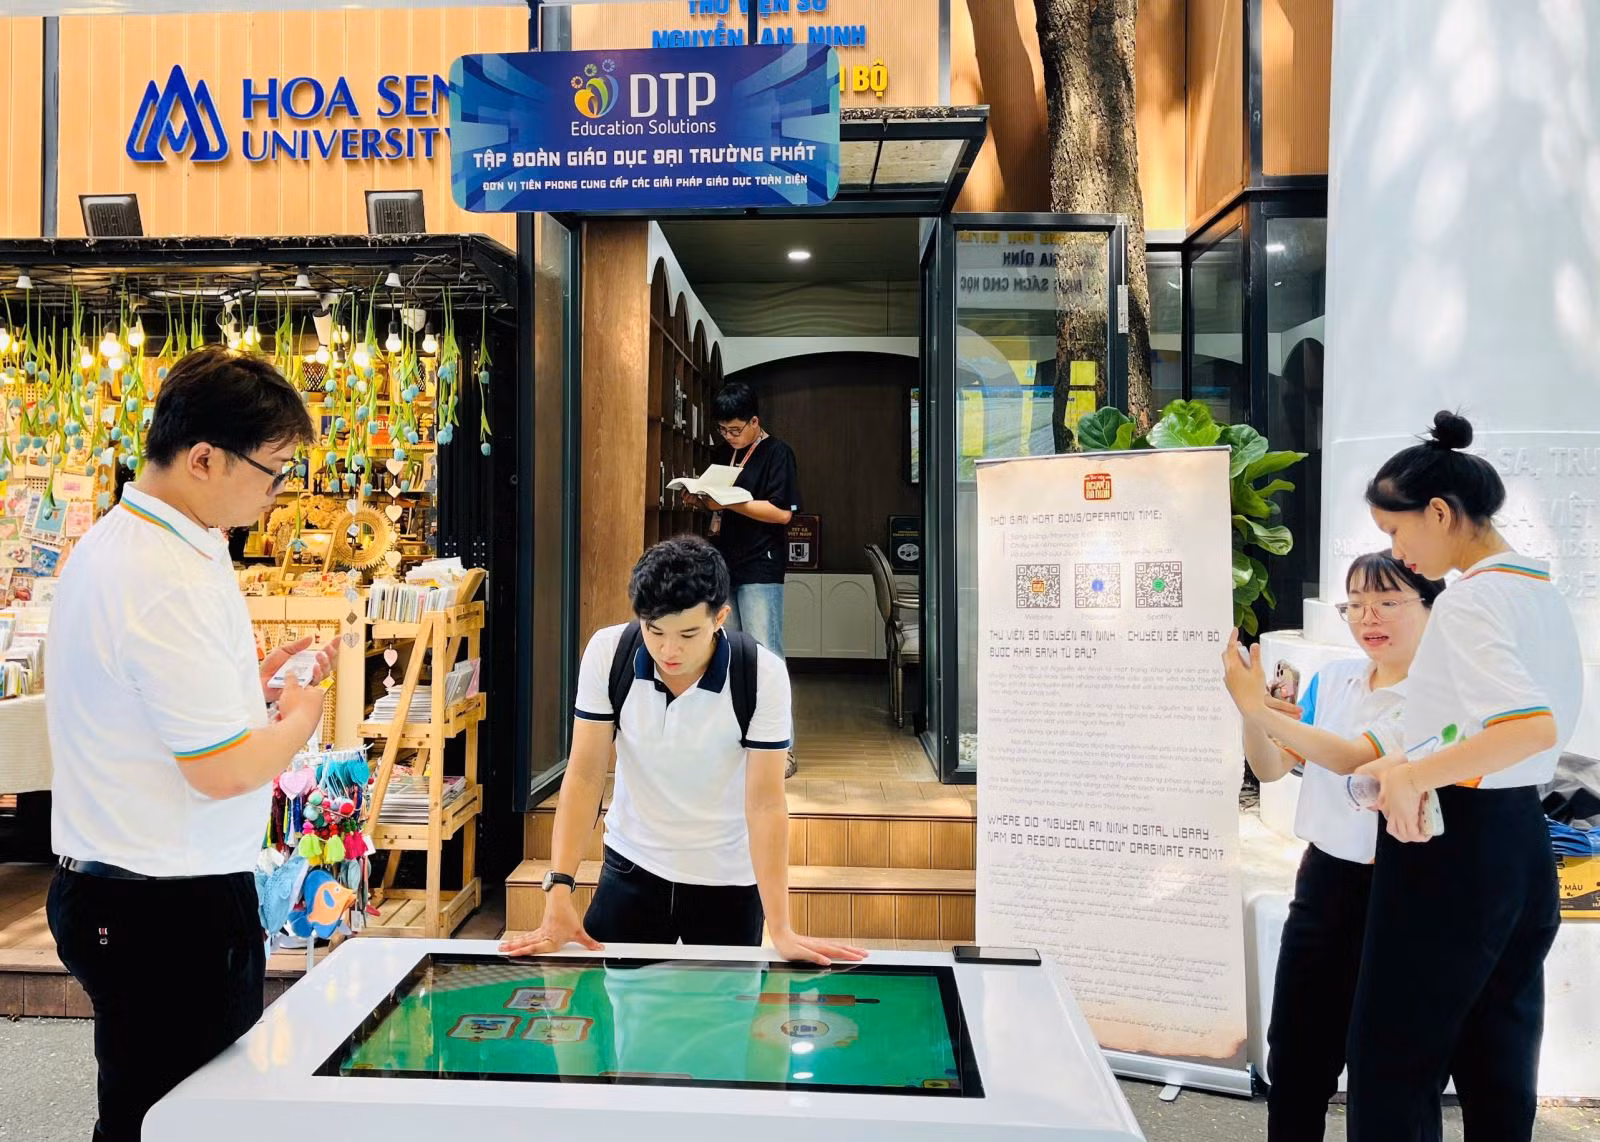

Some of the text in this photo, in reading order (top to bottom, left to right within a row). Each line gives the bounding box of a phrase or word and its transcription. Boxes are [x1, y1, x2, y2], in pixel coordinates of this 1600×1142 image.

[760, 27, 793, 45] AN
[808, 25, 866, 47] NINH
[853, 58, 888, 97] BỘ
[242, 76, 360, 120] HOA
[630, 72, 716, 118] DTP
[571, 118, 716, 136] Education Solutions
[242, 128, 452, 161] UNIVERSIT
[473, 142, 816, 171] TẬP ĐOÀN GIÁO DỤC ĐẠI TRƯỜNG PHÁT
[508, 181, 517, 192] VỊ
[520, 179, 542, 190] TIÊN
[545, 180, 577, 190] PHONG
[581, 179, 606, 189] CUNG
[609, 176, 628, 188] CẤP
[632, 177, 650, 188] CÁC
[653, 176, 673, 187] GIẢI
[676, 176, 702, 187] PHÁP
[706, 175, 729, 186] GIÁO
[732, 177, 752, 187] DỤC
[755, 174, 782, 185] TOÀN
[785, 173, 807, 186] DIỆN
[988, 814, 1020, 826] WHERE
[1025, 816, 1038, 828] DID
[1089, 820, 1102, 832] AN
[1107, 821, 1128, 834] NINH
[1133, 823, 1168, 838] DIGITAL
[988, 831, 1007, 843] NAM
[1011, 833, 1023, 845] BO
[1028, 834, 1060, 848] REGION
[1189, 846, 1224, 860] FROM?
